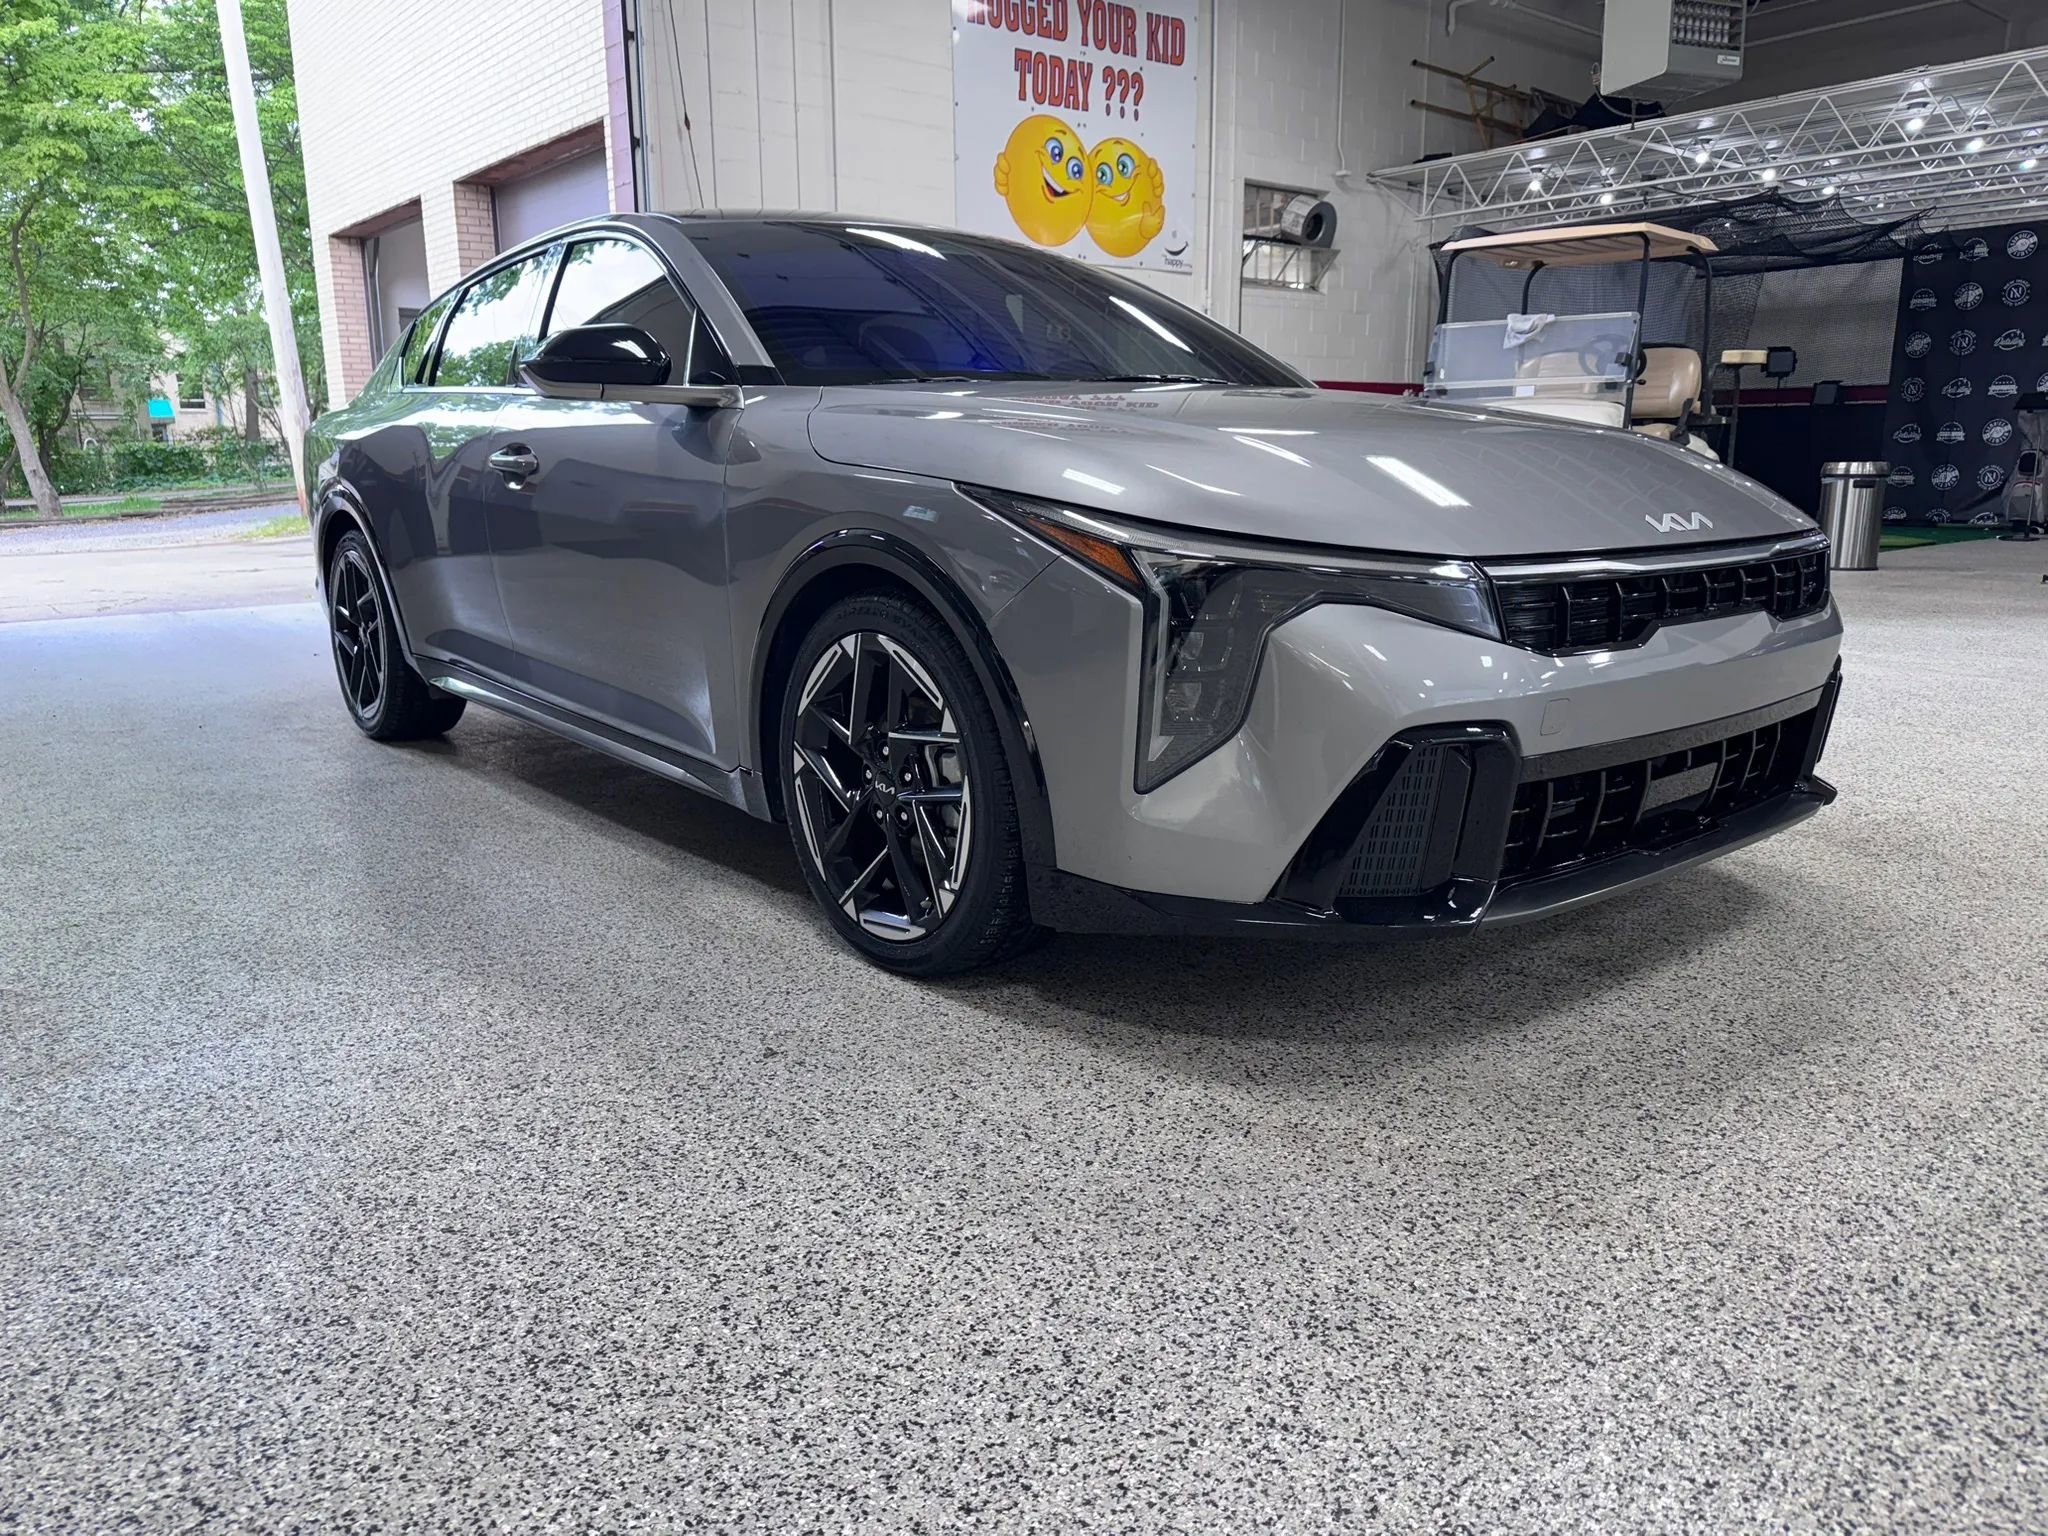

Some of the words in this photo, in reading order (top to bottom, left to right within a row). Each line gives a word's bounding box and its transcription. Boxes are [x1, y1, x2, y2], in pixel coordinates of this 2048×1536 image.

[1076, 0, 1137, 58] YOUR
[1146, 12, 1186, 66] KID
[1014, 48, 1093, 112] TODAY
[1102, 66, 1144, 122] ???
[1645, 511, 1713, 533] KIA
[875, 780, 895, 795] KIA
